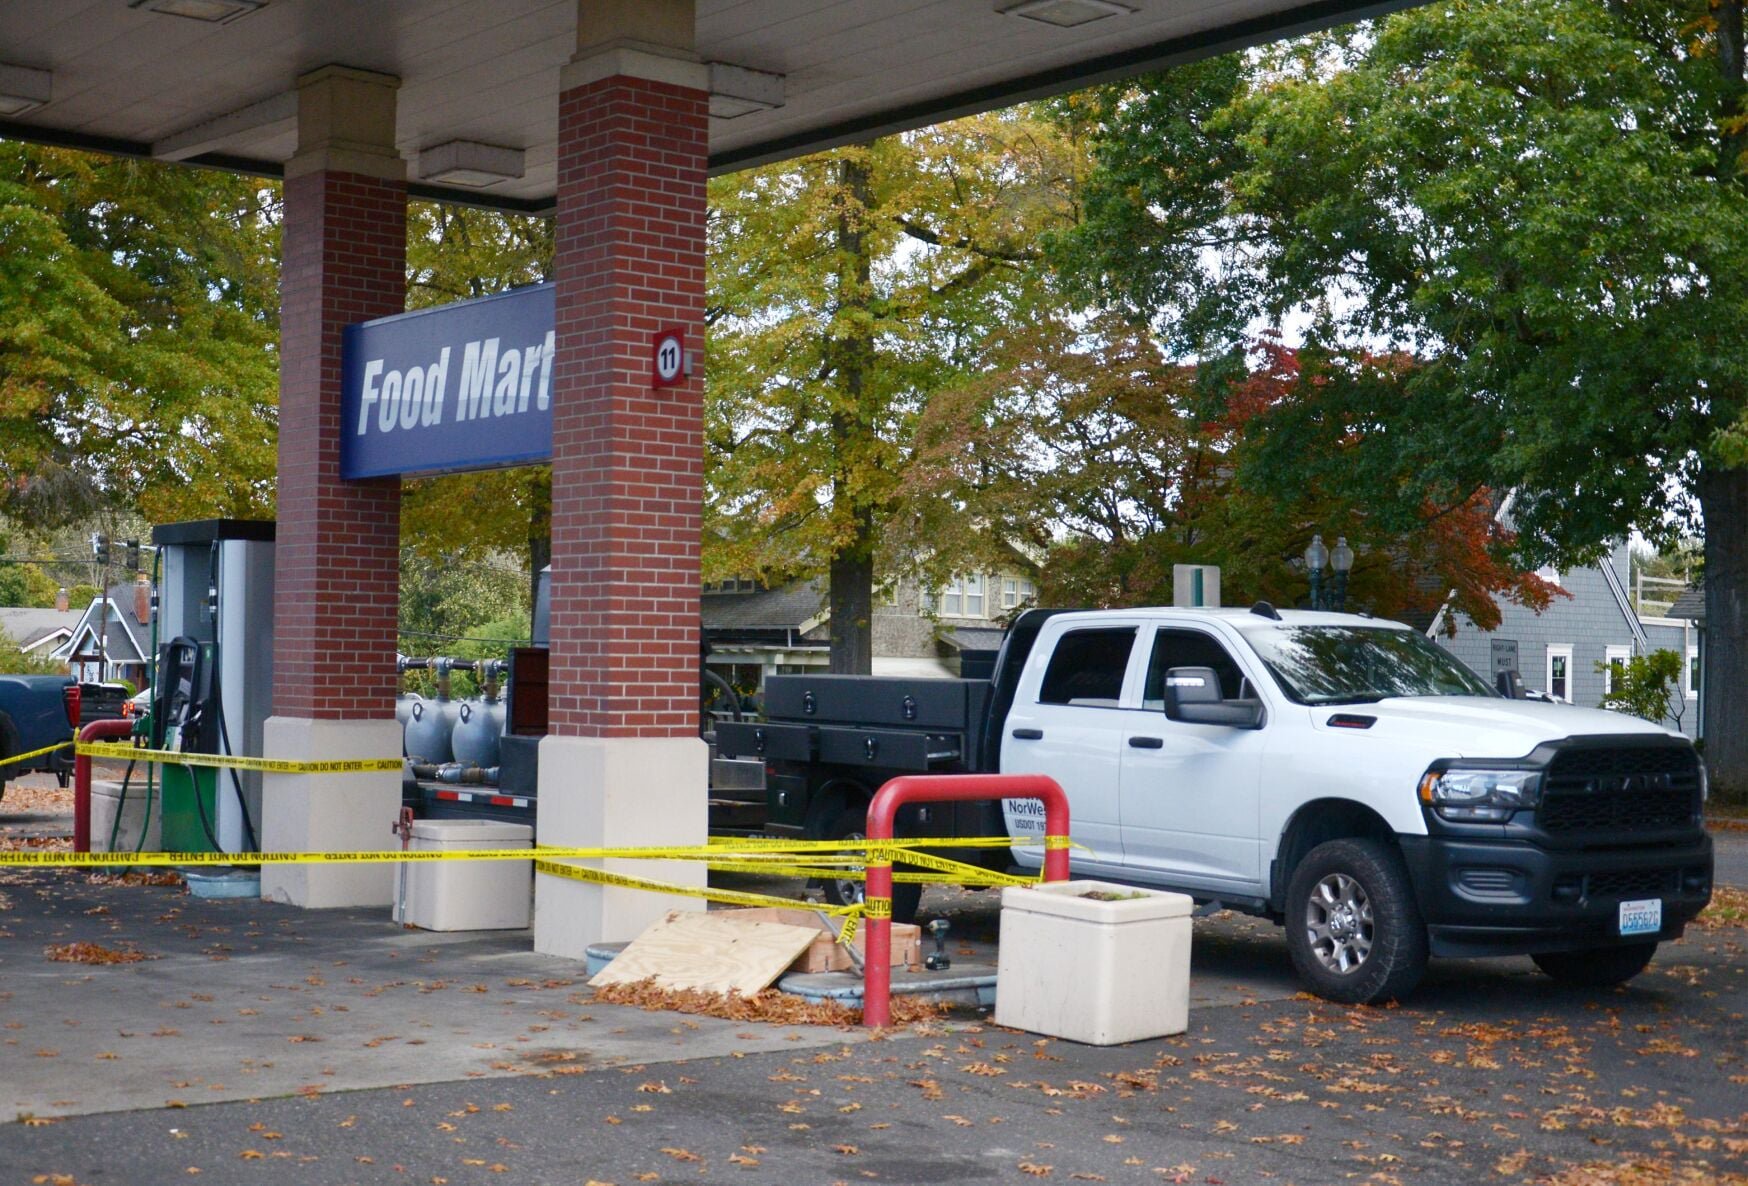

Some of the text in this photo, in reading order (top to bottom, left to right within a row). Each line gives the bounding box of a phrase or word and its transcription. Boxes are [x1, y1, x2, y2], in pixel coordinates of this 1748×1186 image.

[660, 346, 675, 370] 11
[357, 330, 555, 436] Food Mart
[320, 762, 329, 772] DO
[330, 761, 342, 771] NOT
[343, 761, 362, 771] ENTER
[377, 759, 403, 770] CAUTION
[1009, 799, 1045, 815] NorWe
[1014, 819, 1046, 831] USDOT 19
[907, 853, 919, 865] DO
